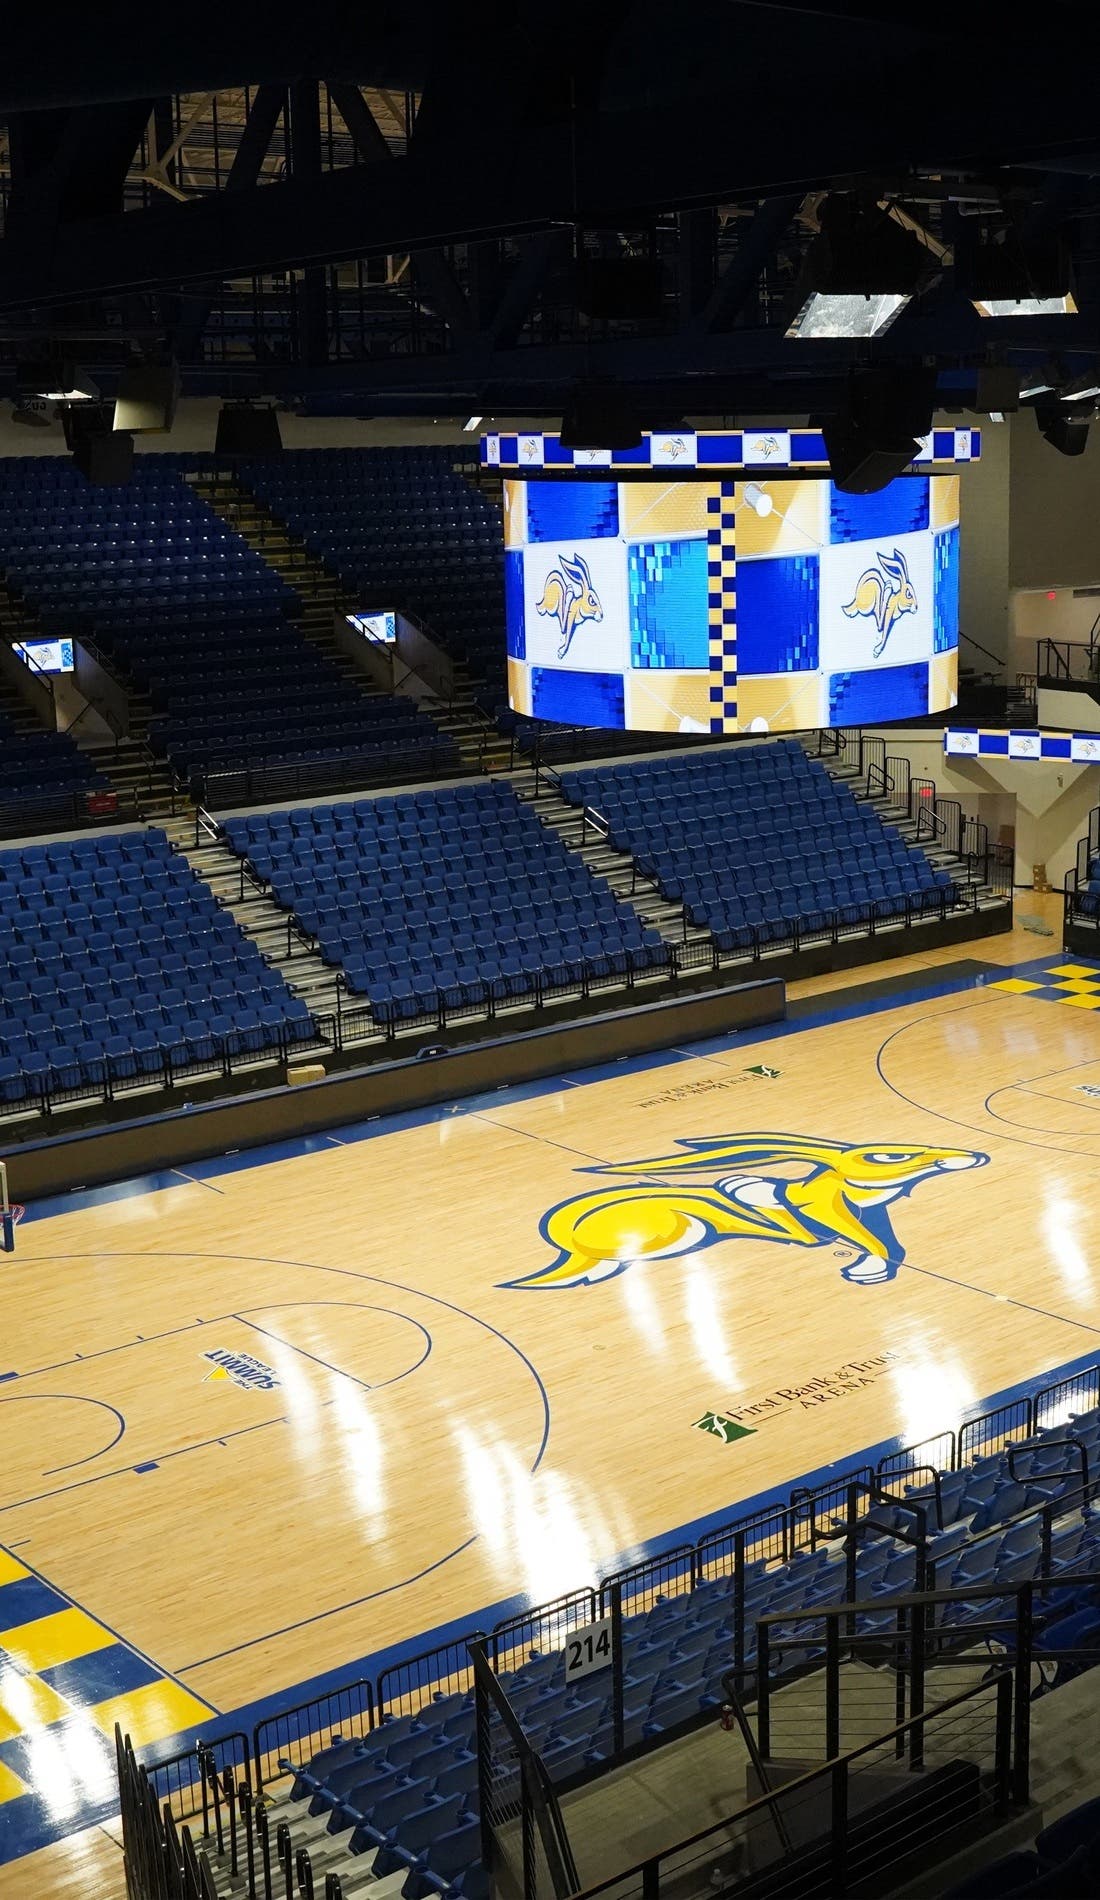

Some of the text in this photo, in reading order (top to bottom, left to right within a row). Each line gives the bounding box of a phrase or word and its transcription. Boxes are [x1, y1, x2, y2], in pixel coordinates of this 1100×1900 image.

[204, 1350, 281, 1389] SUMMIT
[238, 1353, 277, 1375] LEAGUE
[726, 1351, 901, 1421] First Bank & Trust
[800, 1377, 875, 1409] ARENA
[568, 1629, 610, 1671] 214
